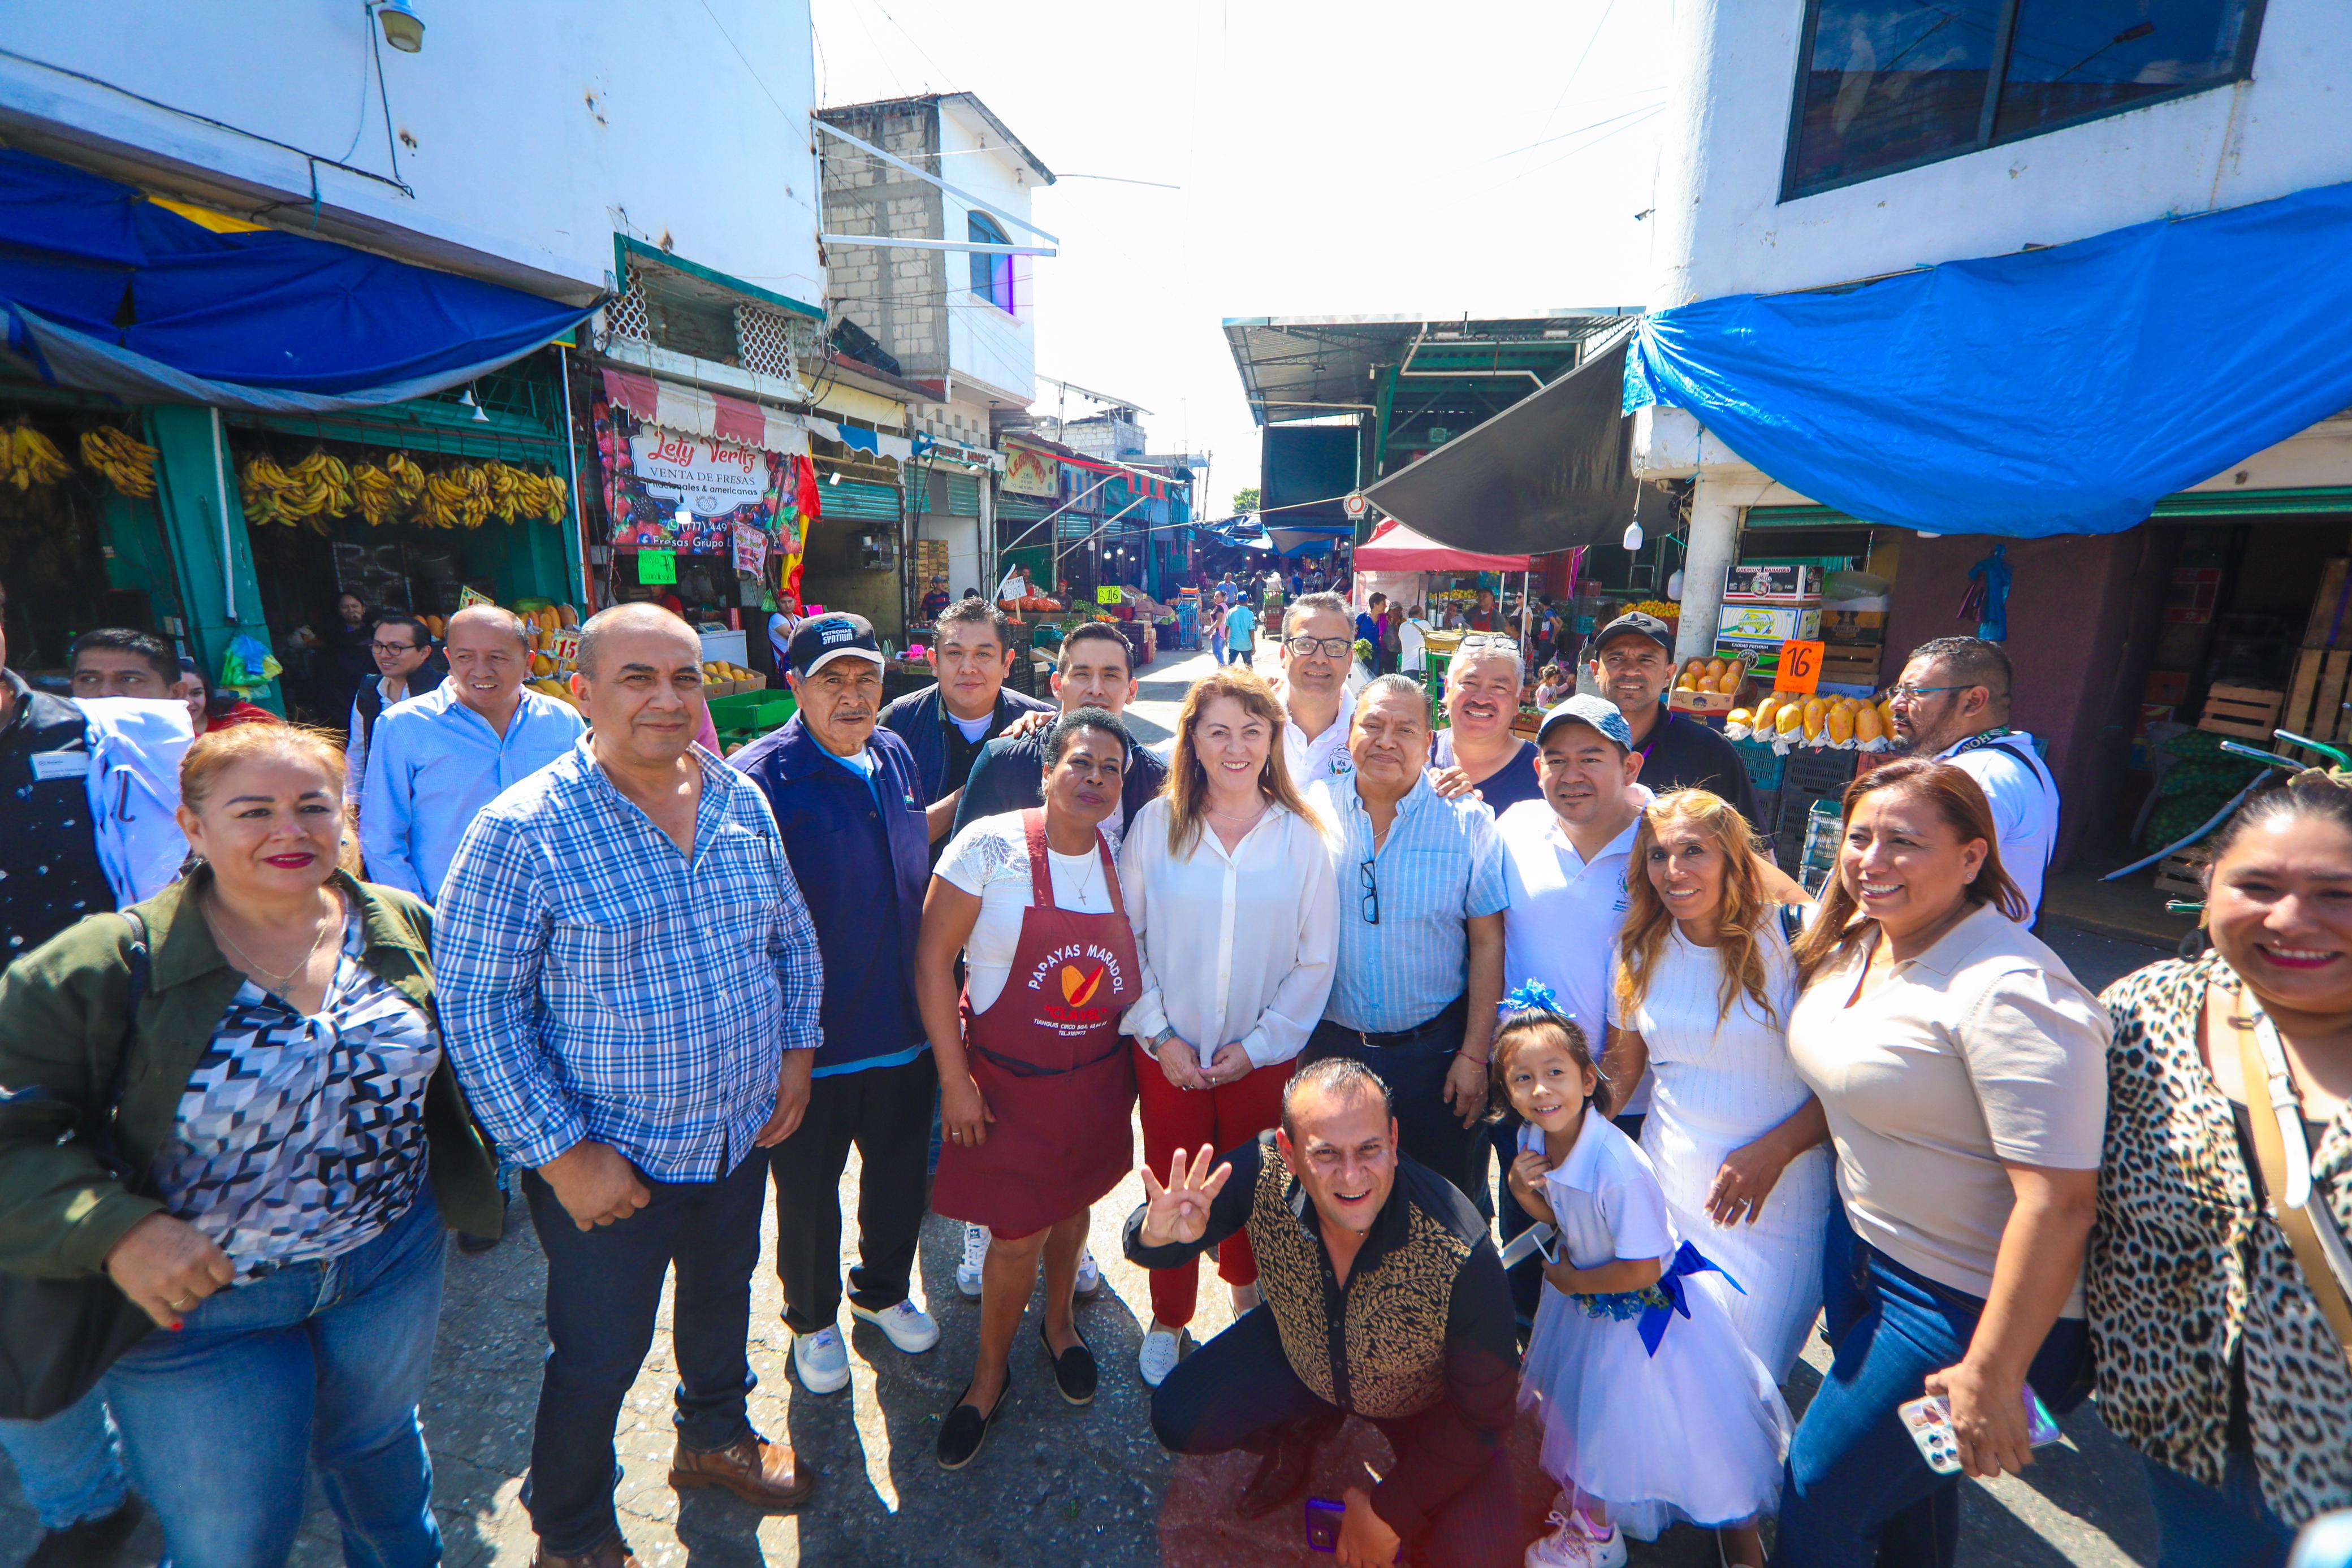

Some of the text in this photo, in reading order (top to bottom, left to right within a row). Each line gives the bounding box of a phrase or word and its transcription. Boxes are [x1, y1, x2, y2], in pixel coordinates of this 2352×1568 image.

[647, 431, 694, 467] Lety
[1008, 452, 1046, 484] LEGUMBRES
[650, 467, 755, 486] VENTA DE FRESAS
[710, 486, 758, 495] americanas
[710, 522, 727, 532] 449
[653, 535, 688, 547] Fresas
[693, 537, 724, 549] Grupo
[822, 629, 852, 637] PETRONAS
[823, 633, 853, 645] SYNTIUM
[1787, 647, 1812, 677] 16
[1028, 944, 1080, 990] PAPAYAS
[1087, 945, 1123, 994] MARADOL
[1034, 1018, 1058, 1028] TIANGUIS
